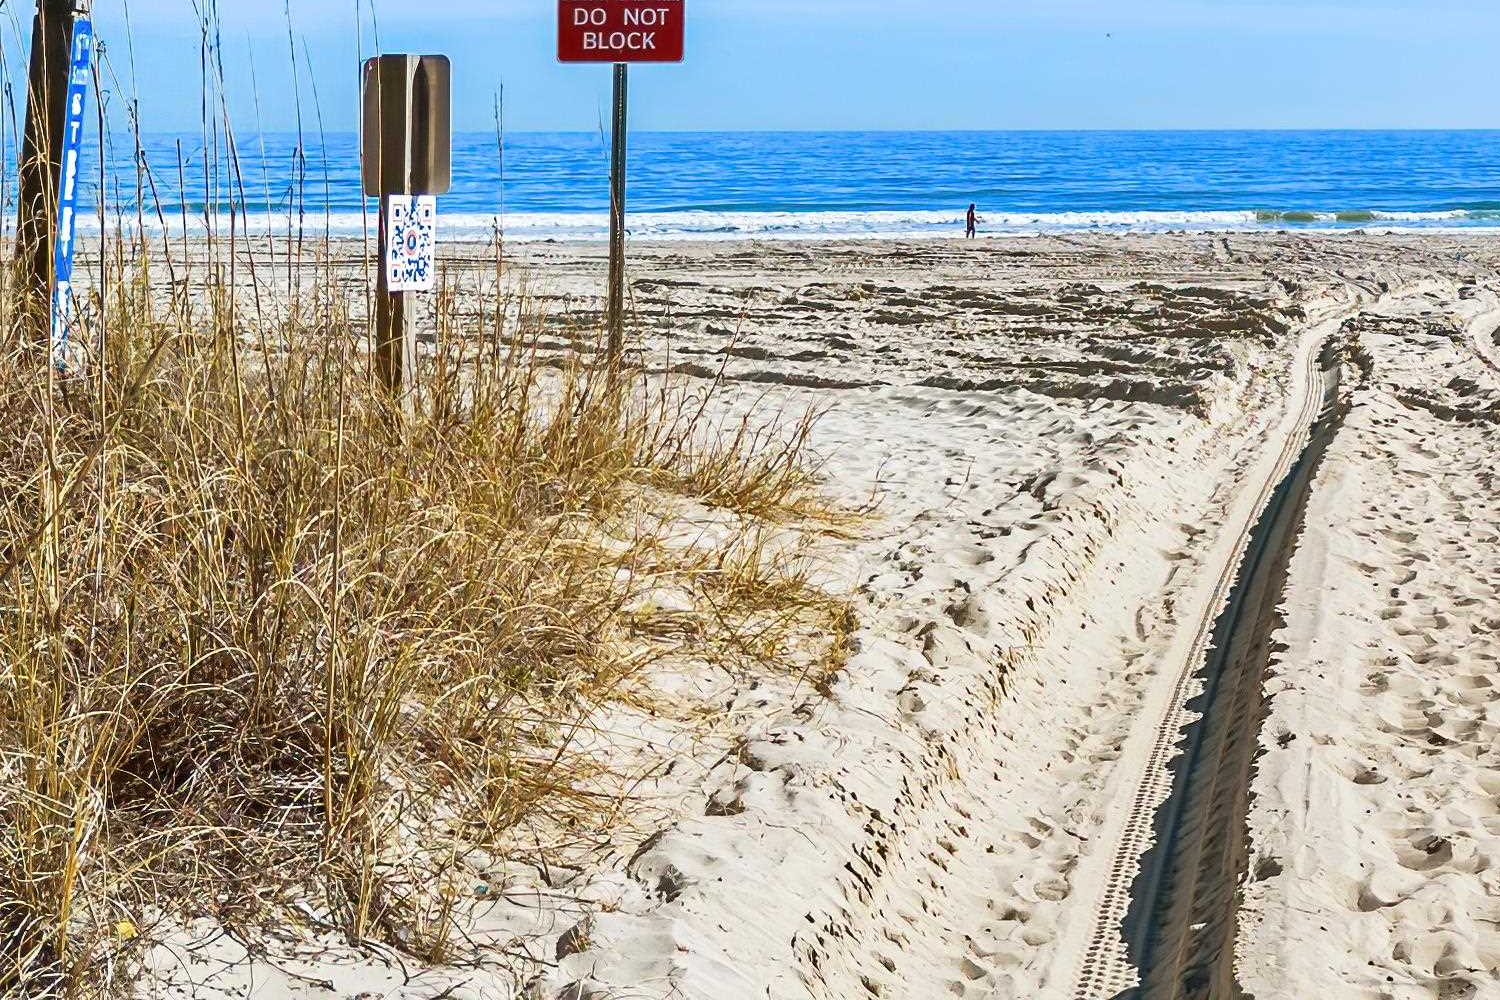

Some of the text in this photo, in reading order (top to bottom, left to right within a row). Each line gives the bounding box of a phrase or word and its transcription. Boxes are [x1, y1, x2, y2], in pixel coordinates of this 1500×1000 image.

[573, 8, 669, 26] DO NOT
[583, 31, 656, 50] BLOCK
